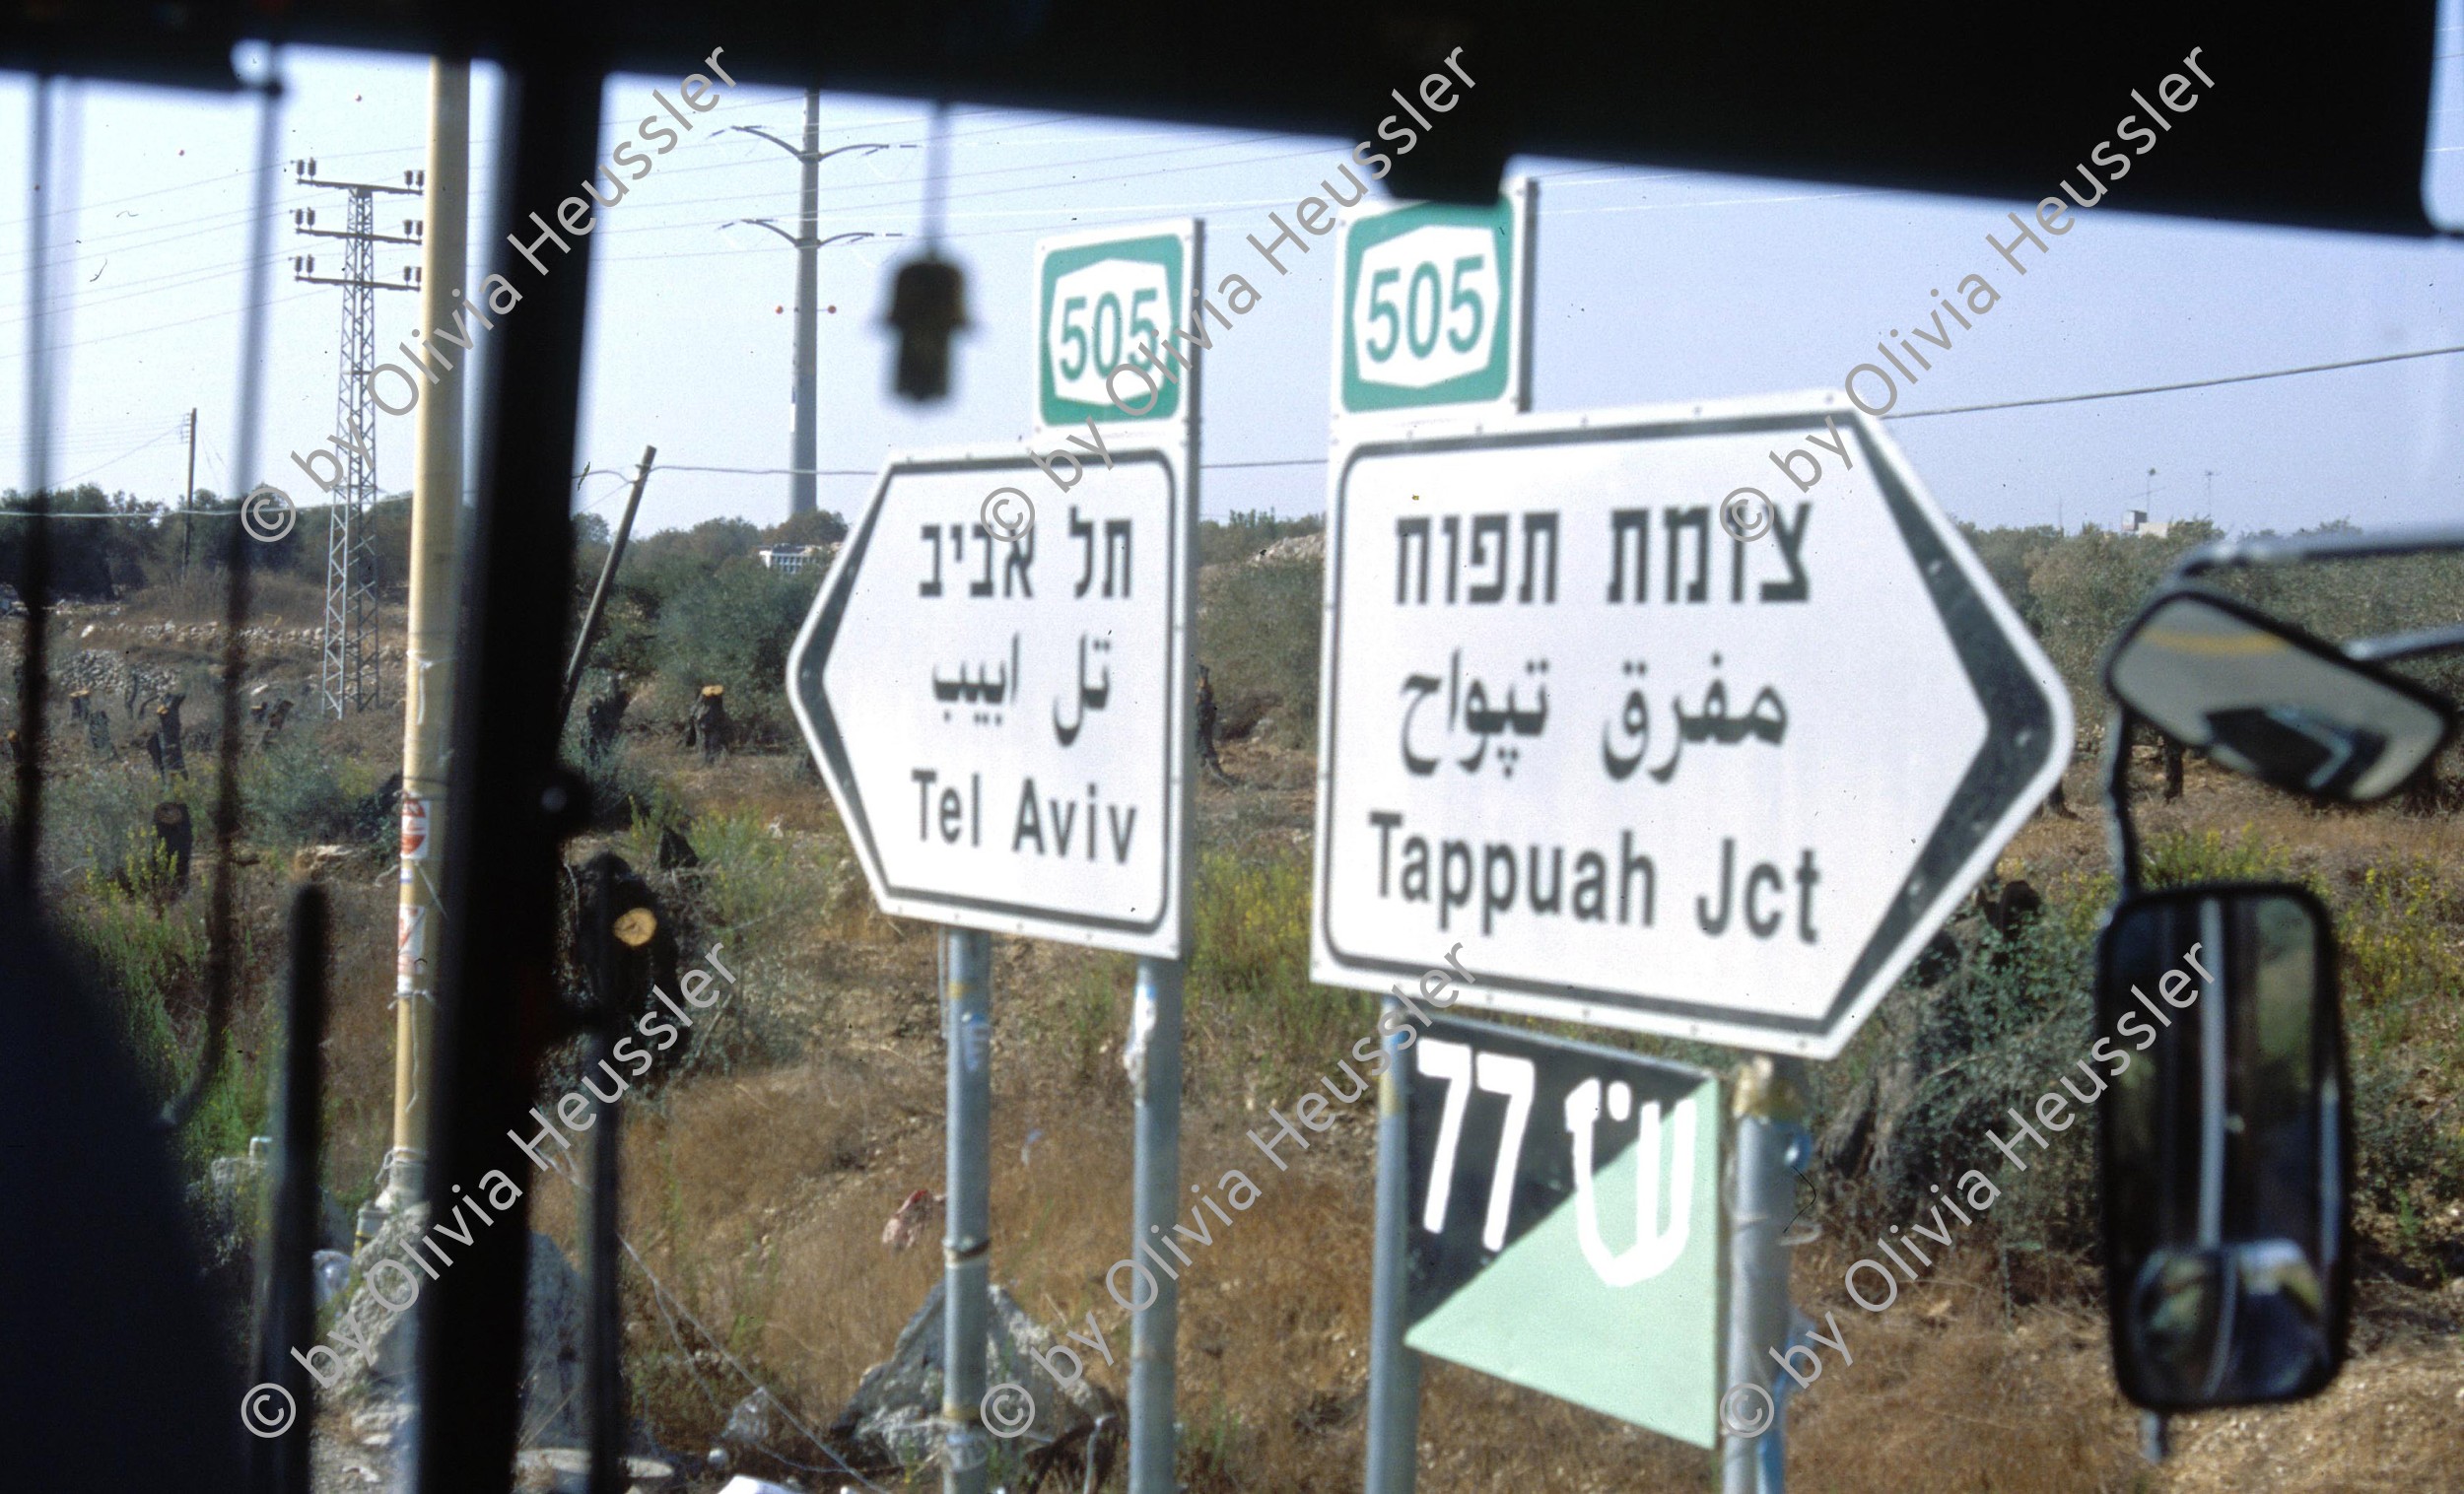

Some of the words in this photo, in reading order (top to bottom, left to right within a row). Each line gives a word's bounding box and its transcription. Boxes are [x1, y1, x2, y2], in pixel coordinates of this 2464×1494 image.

[1060, 288, 1158, 381] 505
[1366, 255, 1485, 363] 505
[919, 522, 1035, 598] אביב
[1069, 505, 1132, 598] תל
[1396, 511, 1559, 605] תפוח
[1606, 503, 1812, 604] צומת
[1054, 632, 1111, 747] تل
[1603, 652, 1789, 783] مفرق
[911, 768, 981, 848] Tel
[1012, 778, 1137, 864] Aviv
[1369, 810, 1656, 937] Tappuah
[1696, 838, 1820, 945] Jct
